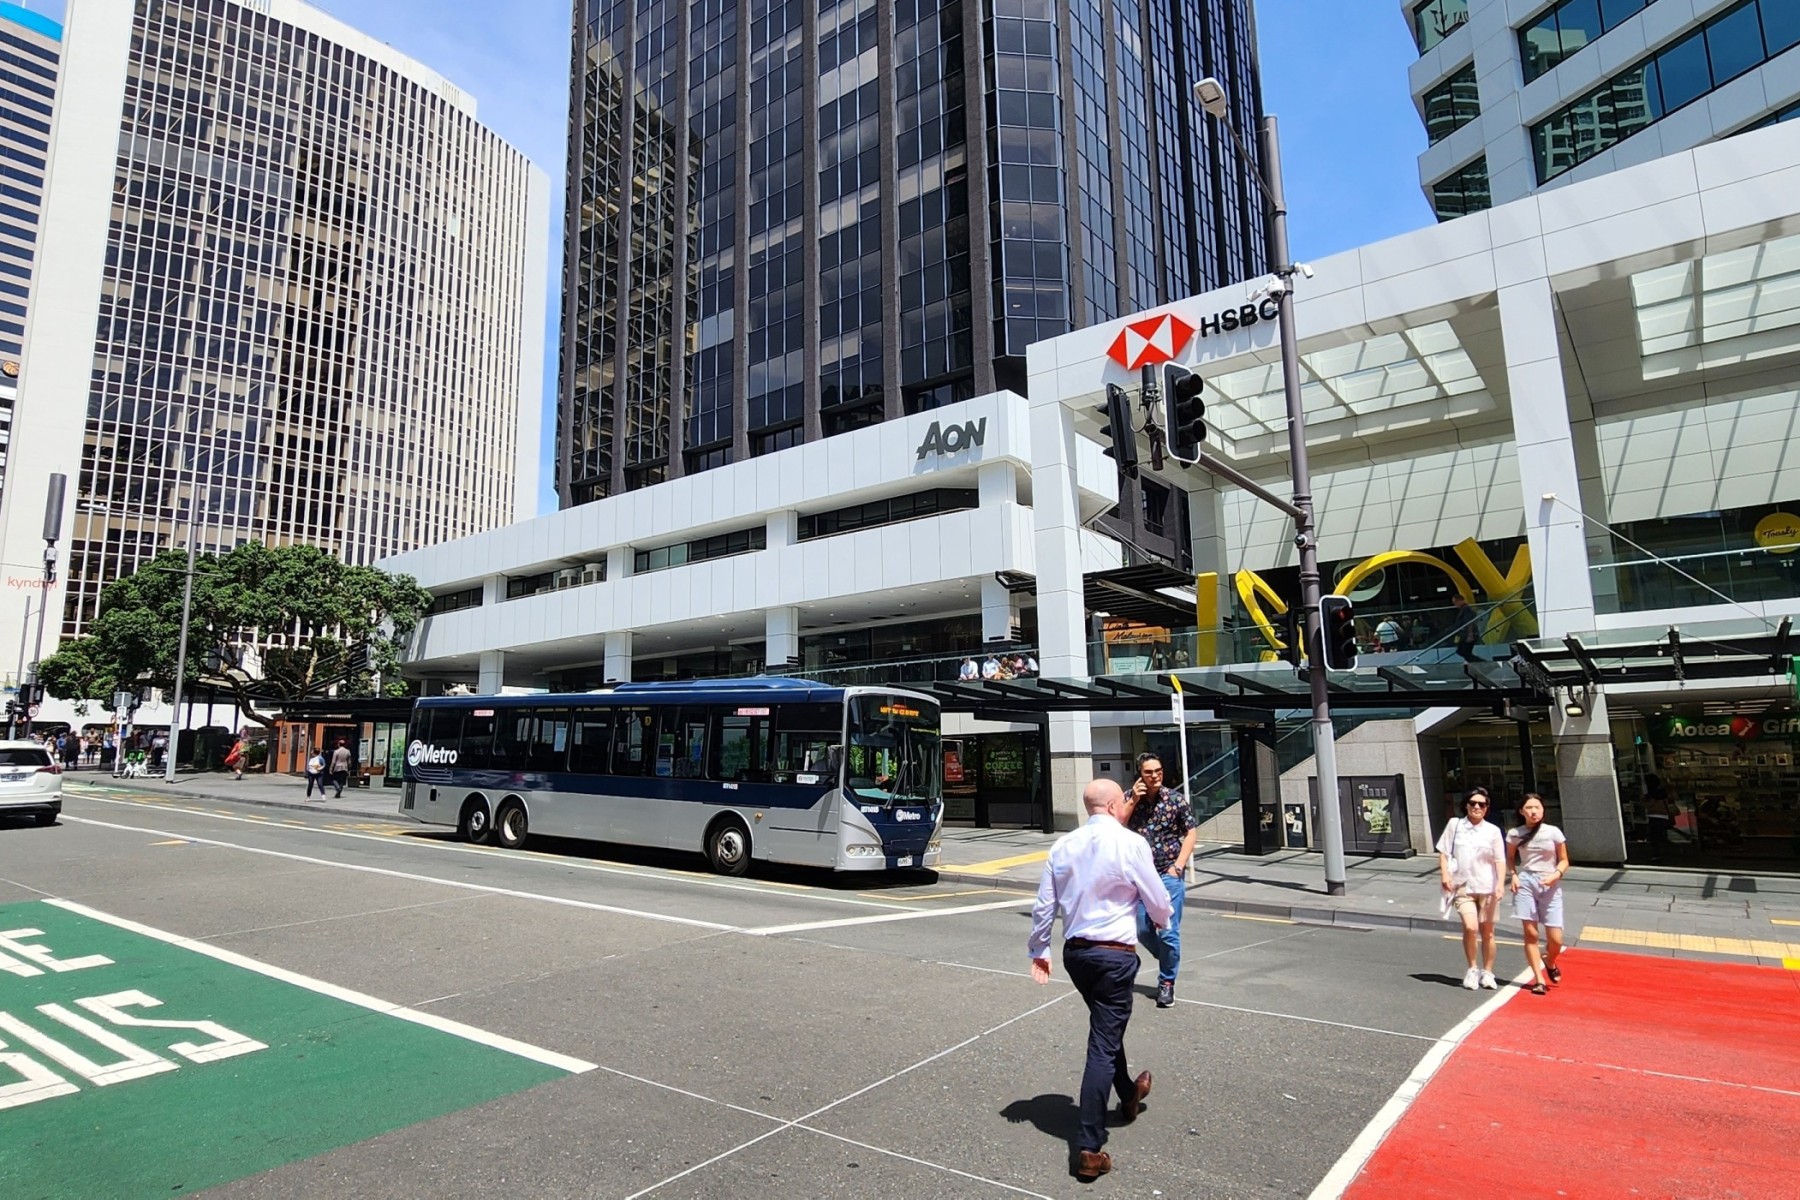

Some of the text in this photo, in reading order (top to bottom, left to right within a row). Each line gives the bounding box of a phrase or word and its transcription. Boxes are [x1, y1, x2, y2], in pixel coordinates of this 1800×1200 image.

[1200, 298, 1279, 338] HSBC
[916, 416, 987, 461] AON
[7, 575, 58, 591] kyndyl
[1669, 722, 1731, 737] Aotea
[421, 744, 458, 764] Metro
[985, 761, 1023, 770] COFFEE
[903, 811, 921, 821] Metro
